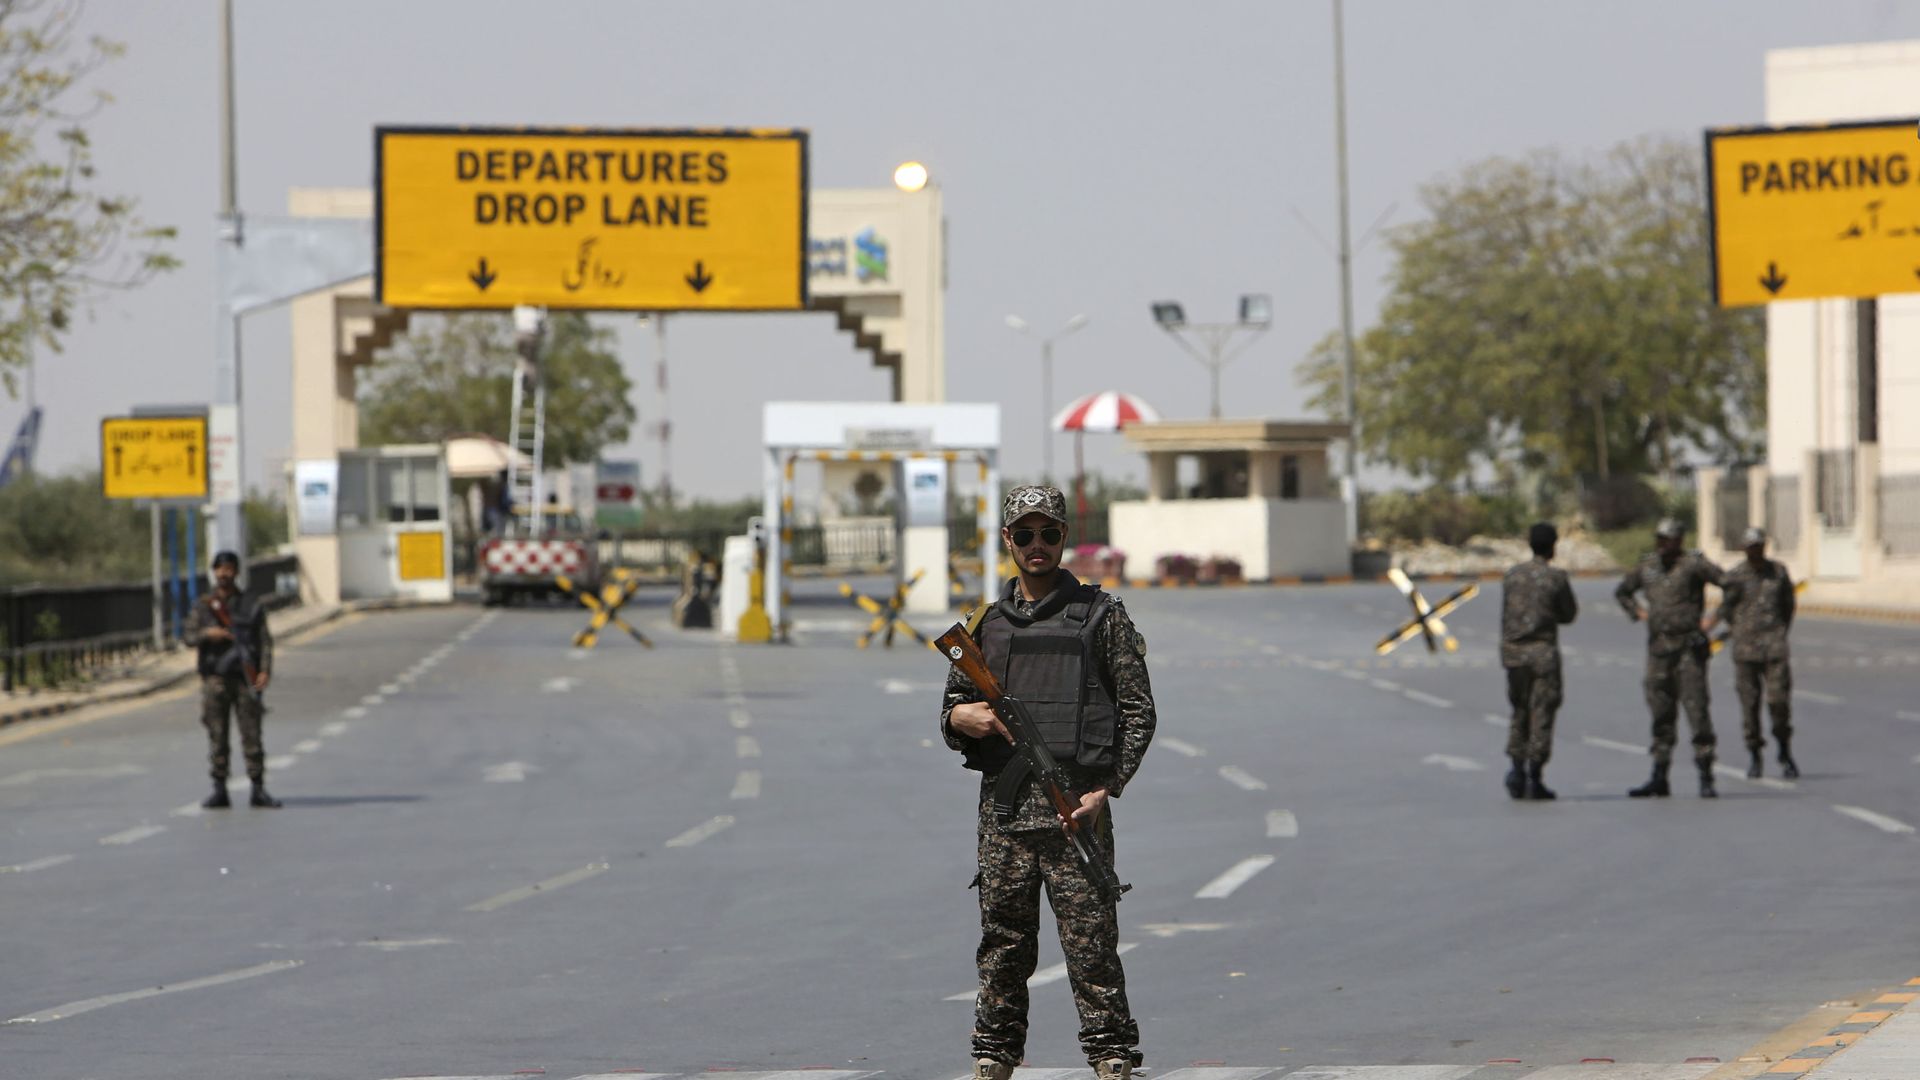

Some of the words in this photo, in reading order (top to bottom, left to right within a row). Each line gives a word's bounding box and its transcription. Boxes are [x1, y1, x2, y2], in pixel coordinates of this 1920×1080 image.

[456, 150, 730, 184] DEPARTURES
[1740, 153, 1910, 193] PARKING
[475, 193, 586, 226] DROP
[602, 196, 710, 228] LANE
